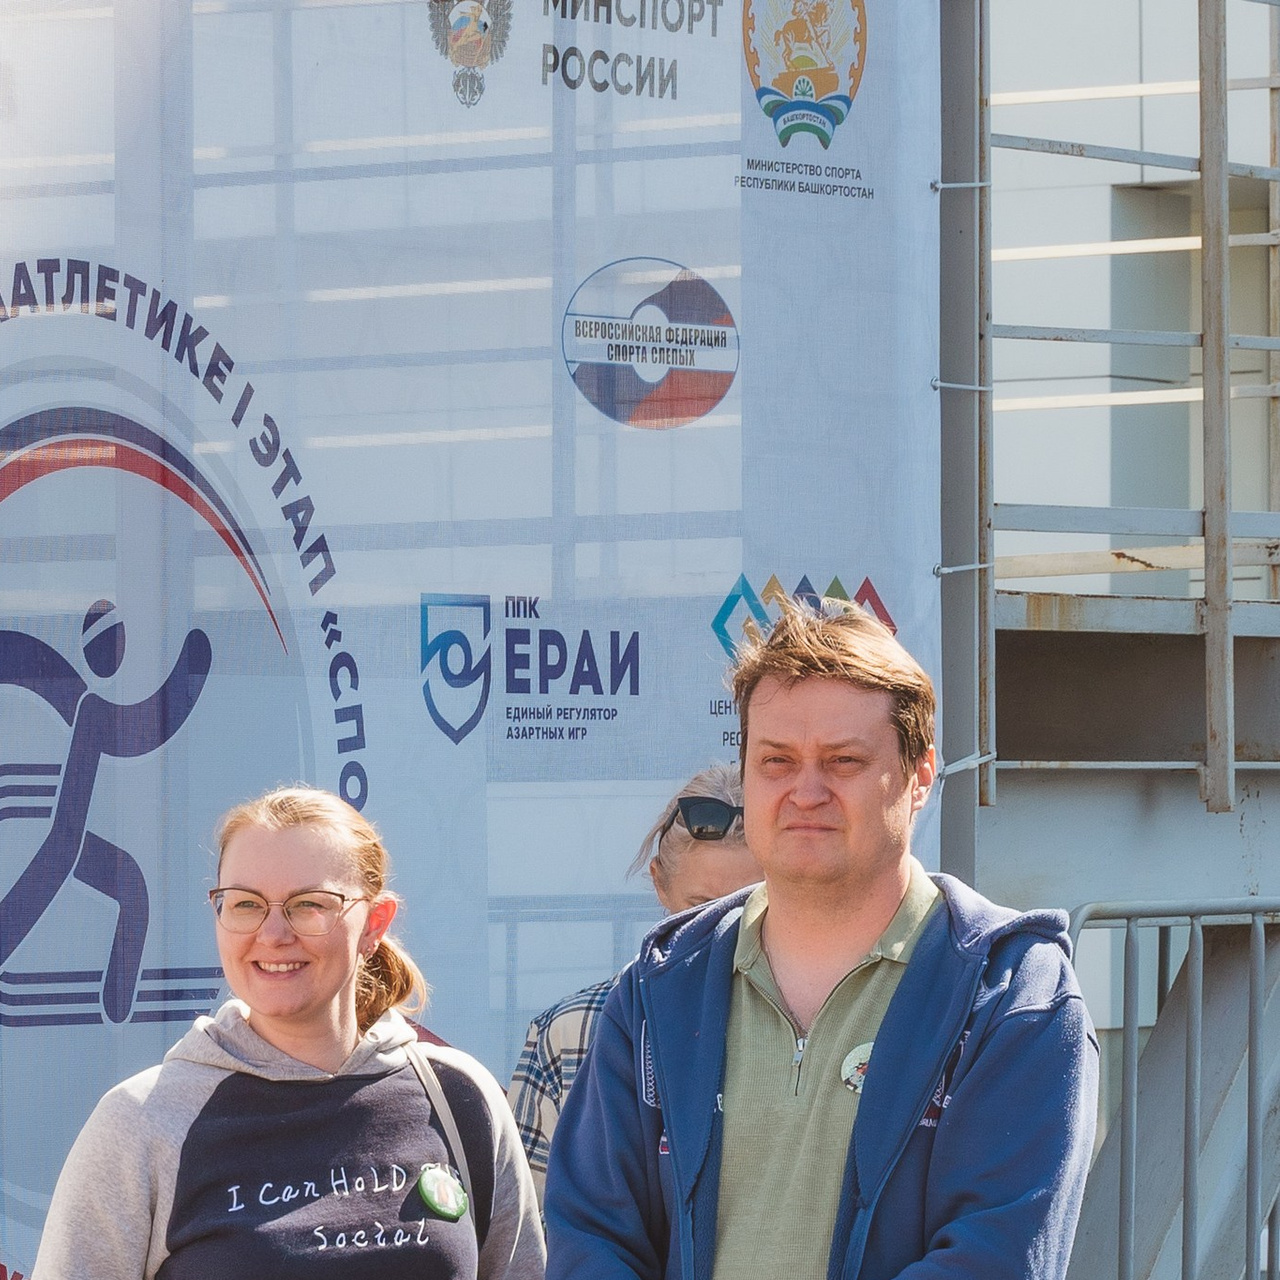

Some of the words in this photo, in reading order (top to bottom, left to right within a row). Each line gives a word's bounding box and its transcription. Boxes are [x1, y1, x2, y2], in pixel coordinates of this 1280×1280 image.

[542, 43, 677, 100] РОССИИ
[782, 113, 827, 128] БАШКОРТОСТАН
[747, 158, 822, 177] МИНИСТЕРСТВО
[824, 166, 862, 181] СПОРТА
[734, 176, 795, 193] РЕСПУБЛИКИ
[798, 181, 875, 200] БАШКОРТОСТАН
[575, 319, 661, 343] ВСЕРОССИЙСКАЯ
[665, 327, 727, 349] ФЕДЕРАЦИЯ
[607, 343, 648, 363] СПОРТА
[651, 346, 695, 367] СЛЕПЫХ
[249, 413, 336, 596] ЭТАП
[505, 595, 540, 619] ППК
[505, 628, 639, 695] ЕРАИ
[506, 704, 553, 722] ЕДИНЫЙ
[556, 707, 618, 721] РЕГУЛЯТОР
[506, 726, 564, 740] АЗАРТНЫХ
[568, 727, 588, 740] ИГР
[227, 1185, 245, 1212] I
